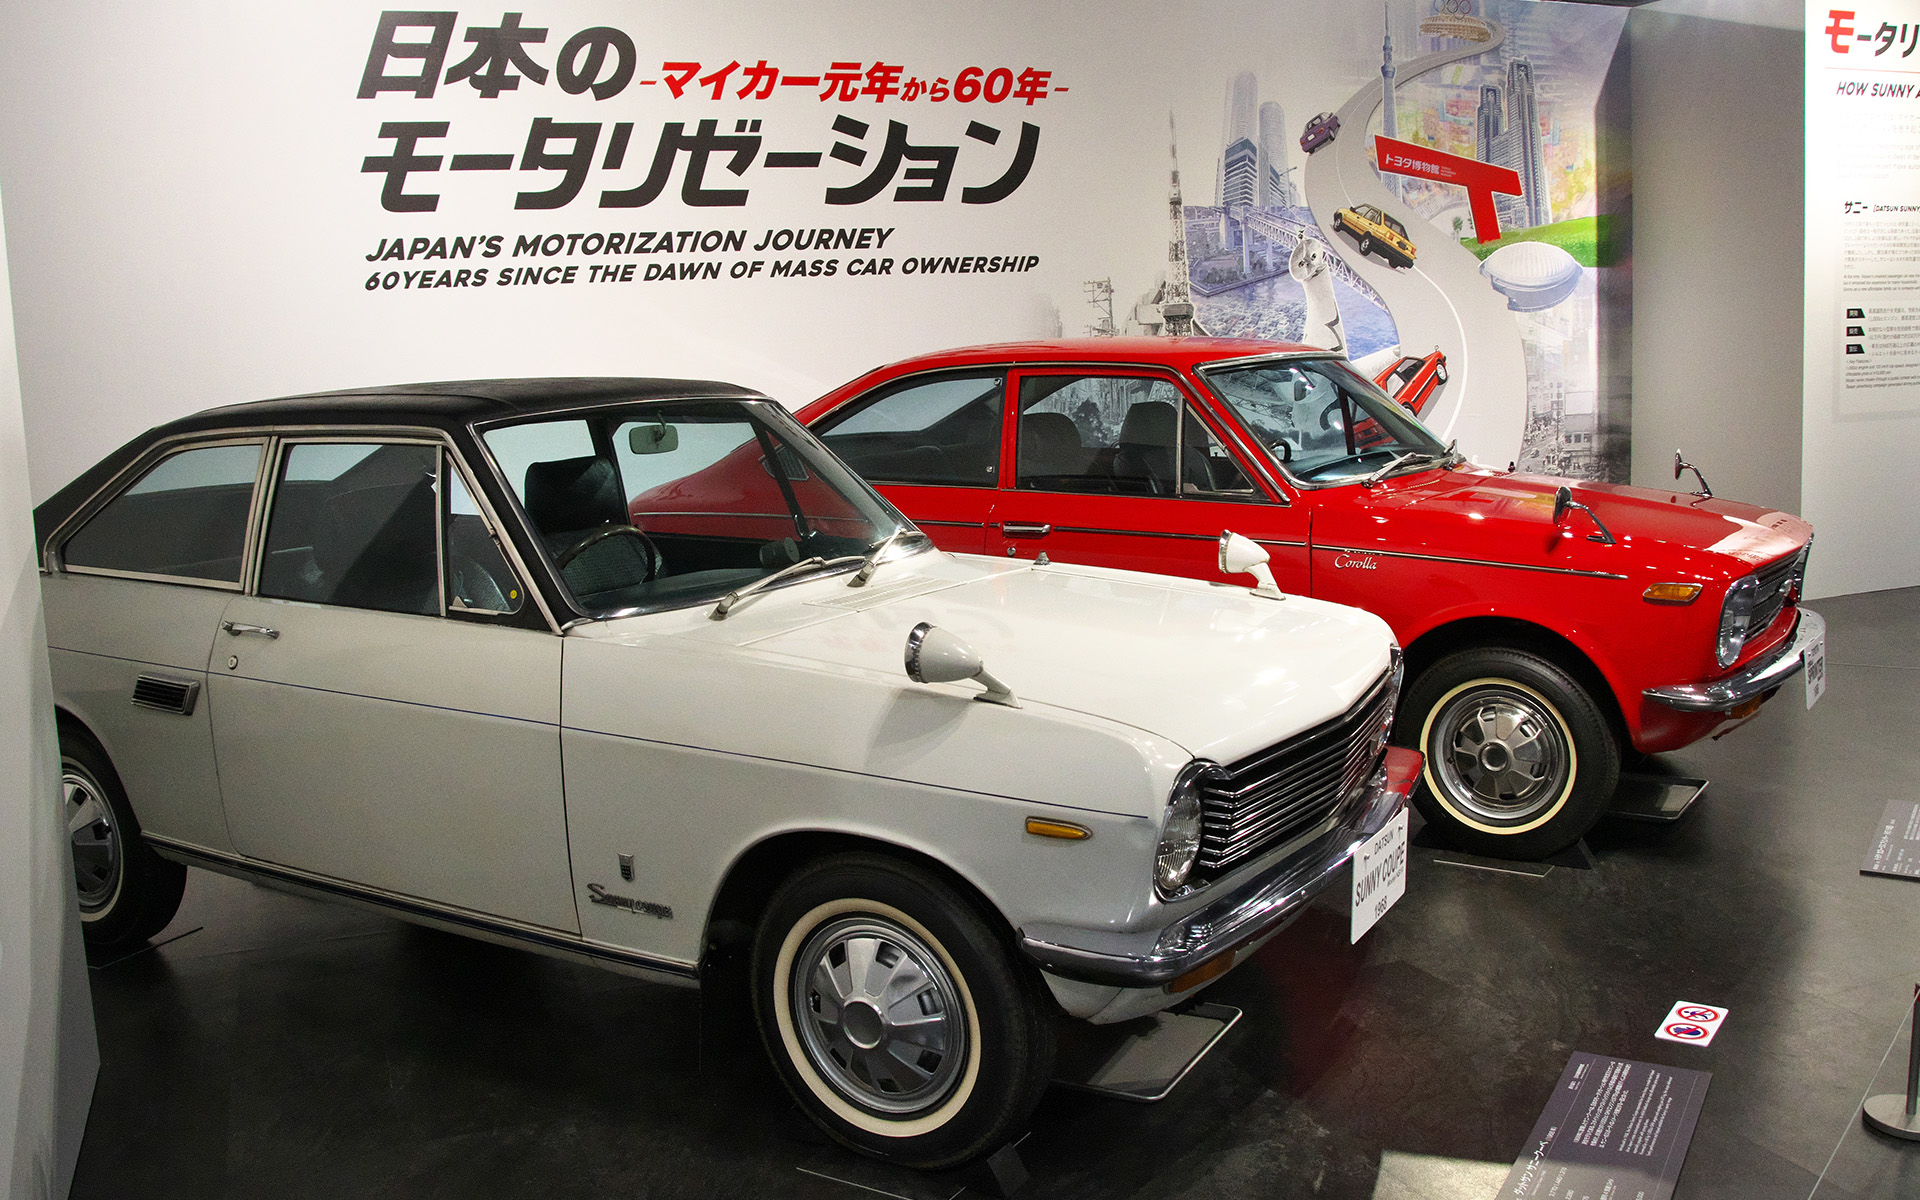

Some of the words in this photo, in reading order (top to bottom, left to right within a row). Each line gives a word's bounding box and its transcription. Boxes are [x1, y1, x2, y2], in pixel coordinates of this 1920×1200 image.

[356, 10, 637, 102] 日本の
[1836, 81, 1869, 96] HOW
[1871, 83, 1915, 98] SUNNY
[360, 114, 1041, 212] モータリゼーション
[1385, 153, 1441, 175] トヨタ博物館
[1845, 201, 1868, 214] サニー
[365, 235, 504, 262] JAPAN'S
[512, 230, 747, 257] MOTORIZATION
[753, 228, 895, 251] JOURNEY
[364, 268, 489, 291] 60YEARS
[496, 266, 579, 286] SINCE
[589, 264, 637, 283] THE
[643, 262, 722, 282] DAWN
[730, 261, 764, 279] OF
[770, 259, 839, 278] MASS
[846, 258, 894, 276] CAR
[901, 255, 1040, 275] OWNERSHIP
[1334, 553, 1377, 570] Corolla
[1374, 829, 1394, 855] DATSUN
[1355, 862, 1382, 907] SUNNY
[1382, 841, 1405, 882] COUPE
